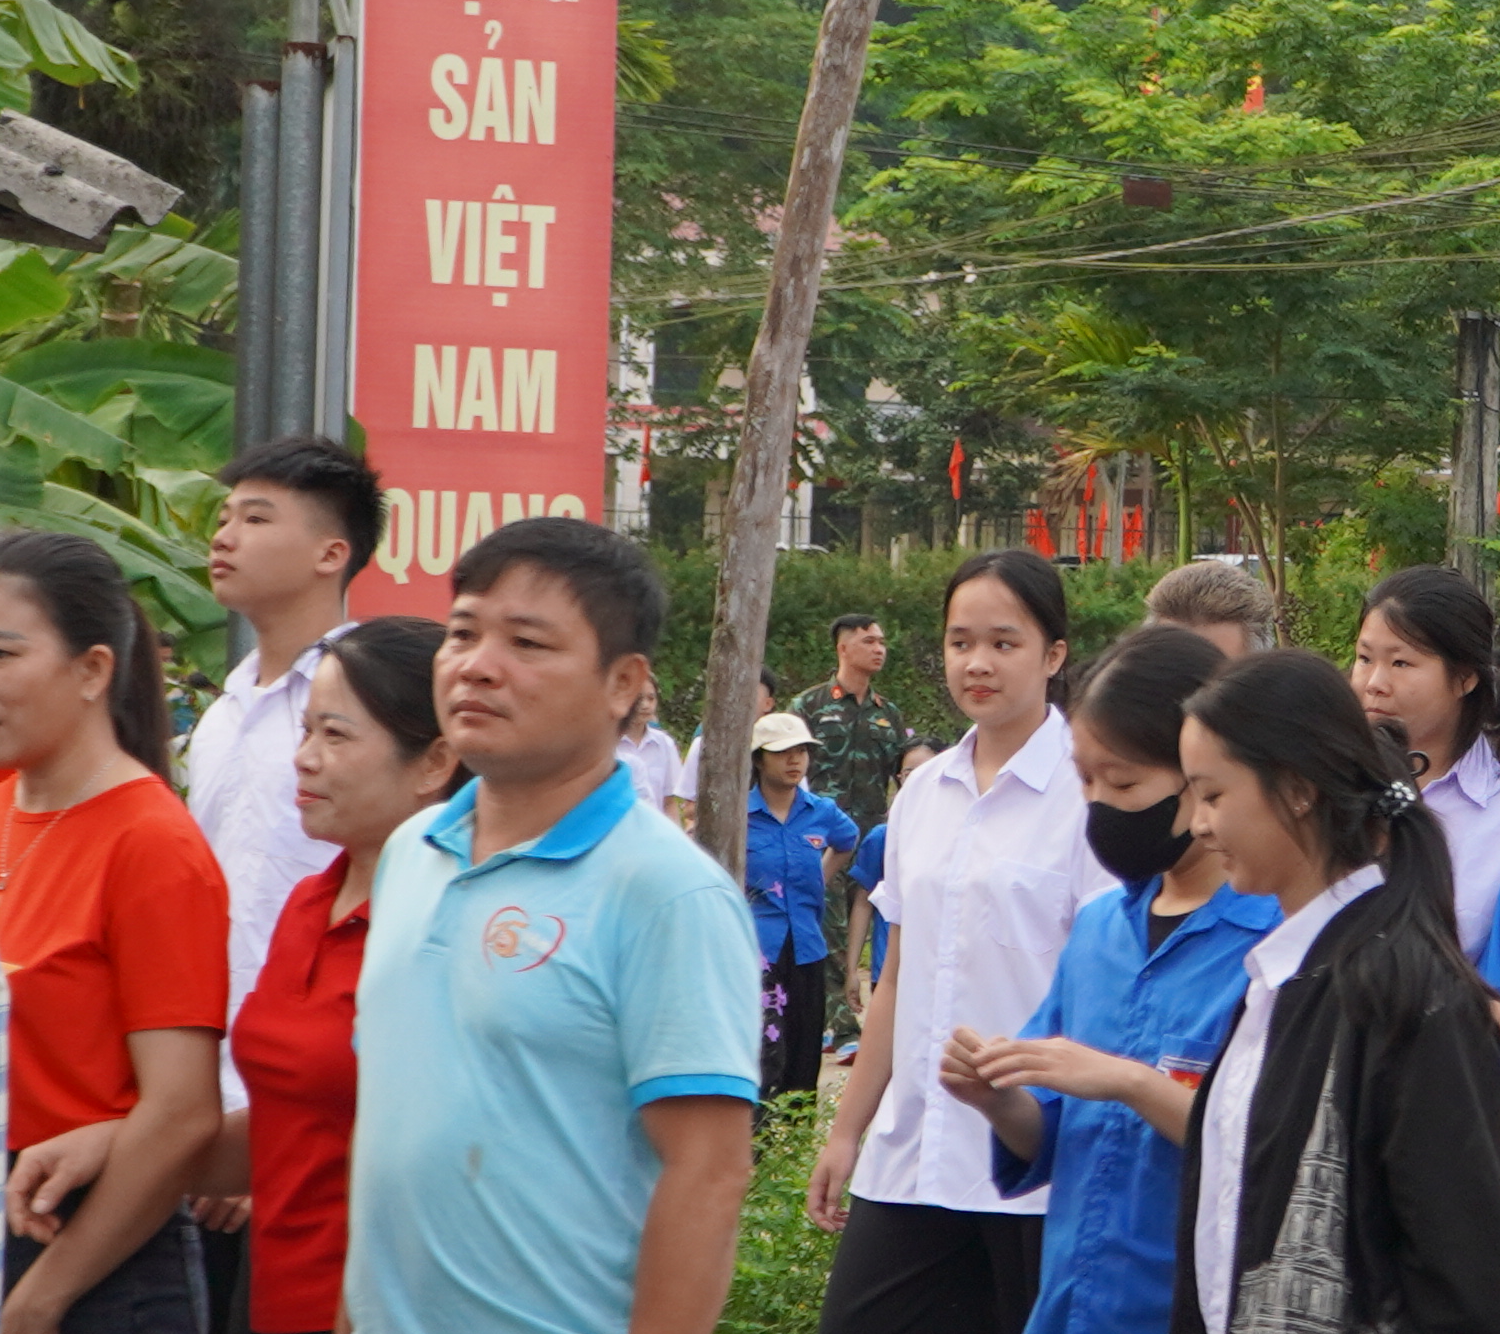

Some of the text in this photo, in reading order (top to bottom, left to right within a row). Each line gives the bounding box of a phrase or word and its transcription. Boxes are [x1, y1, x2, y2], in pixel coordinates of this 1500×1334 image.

[429, 19, 558, 147] SẢN
[425, 184, 557, 309] VIỆT
[412, 344, 559, 436] NAM
[375, 487, 587, 586] QUA
